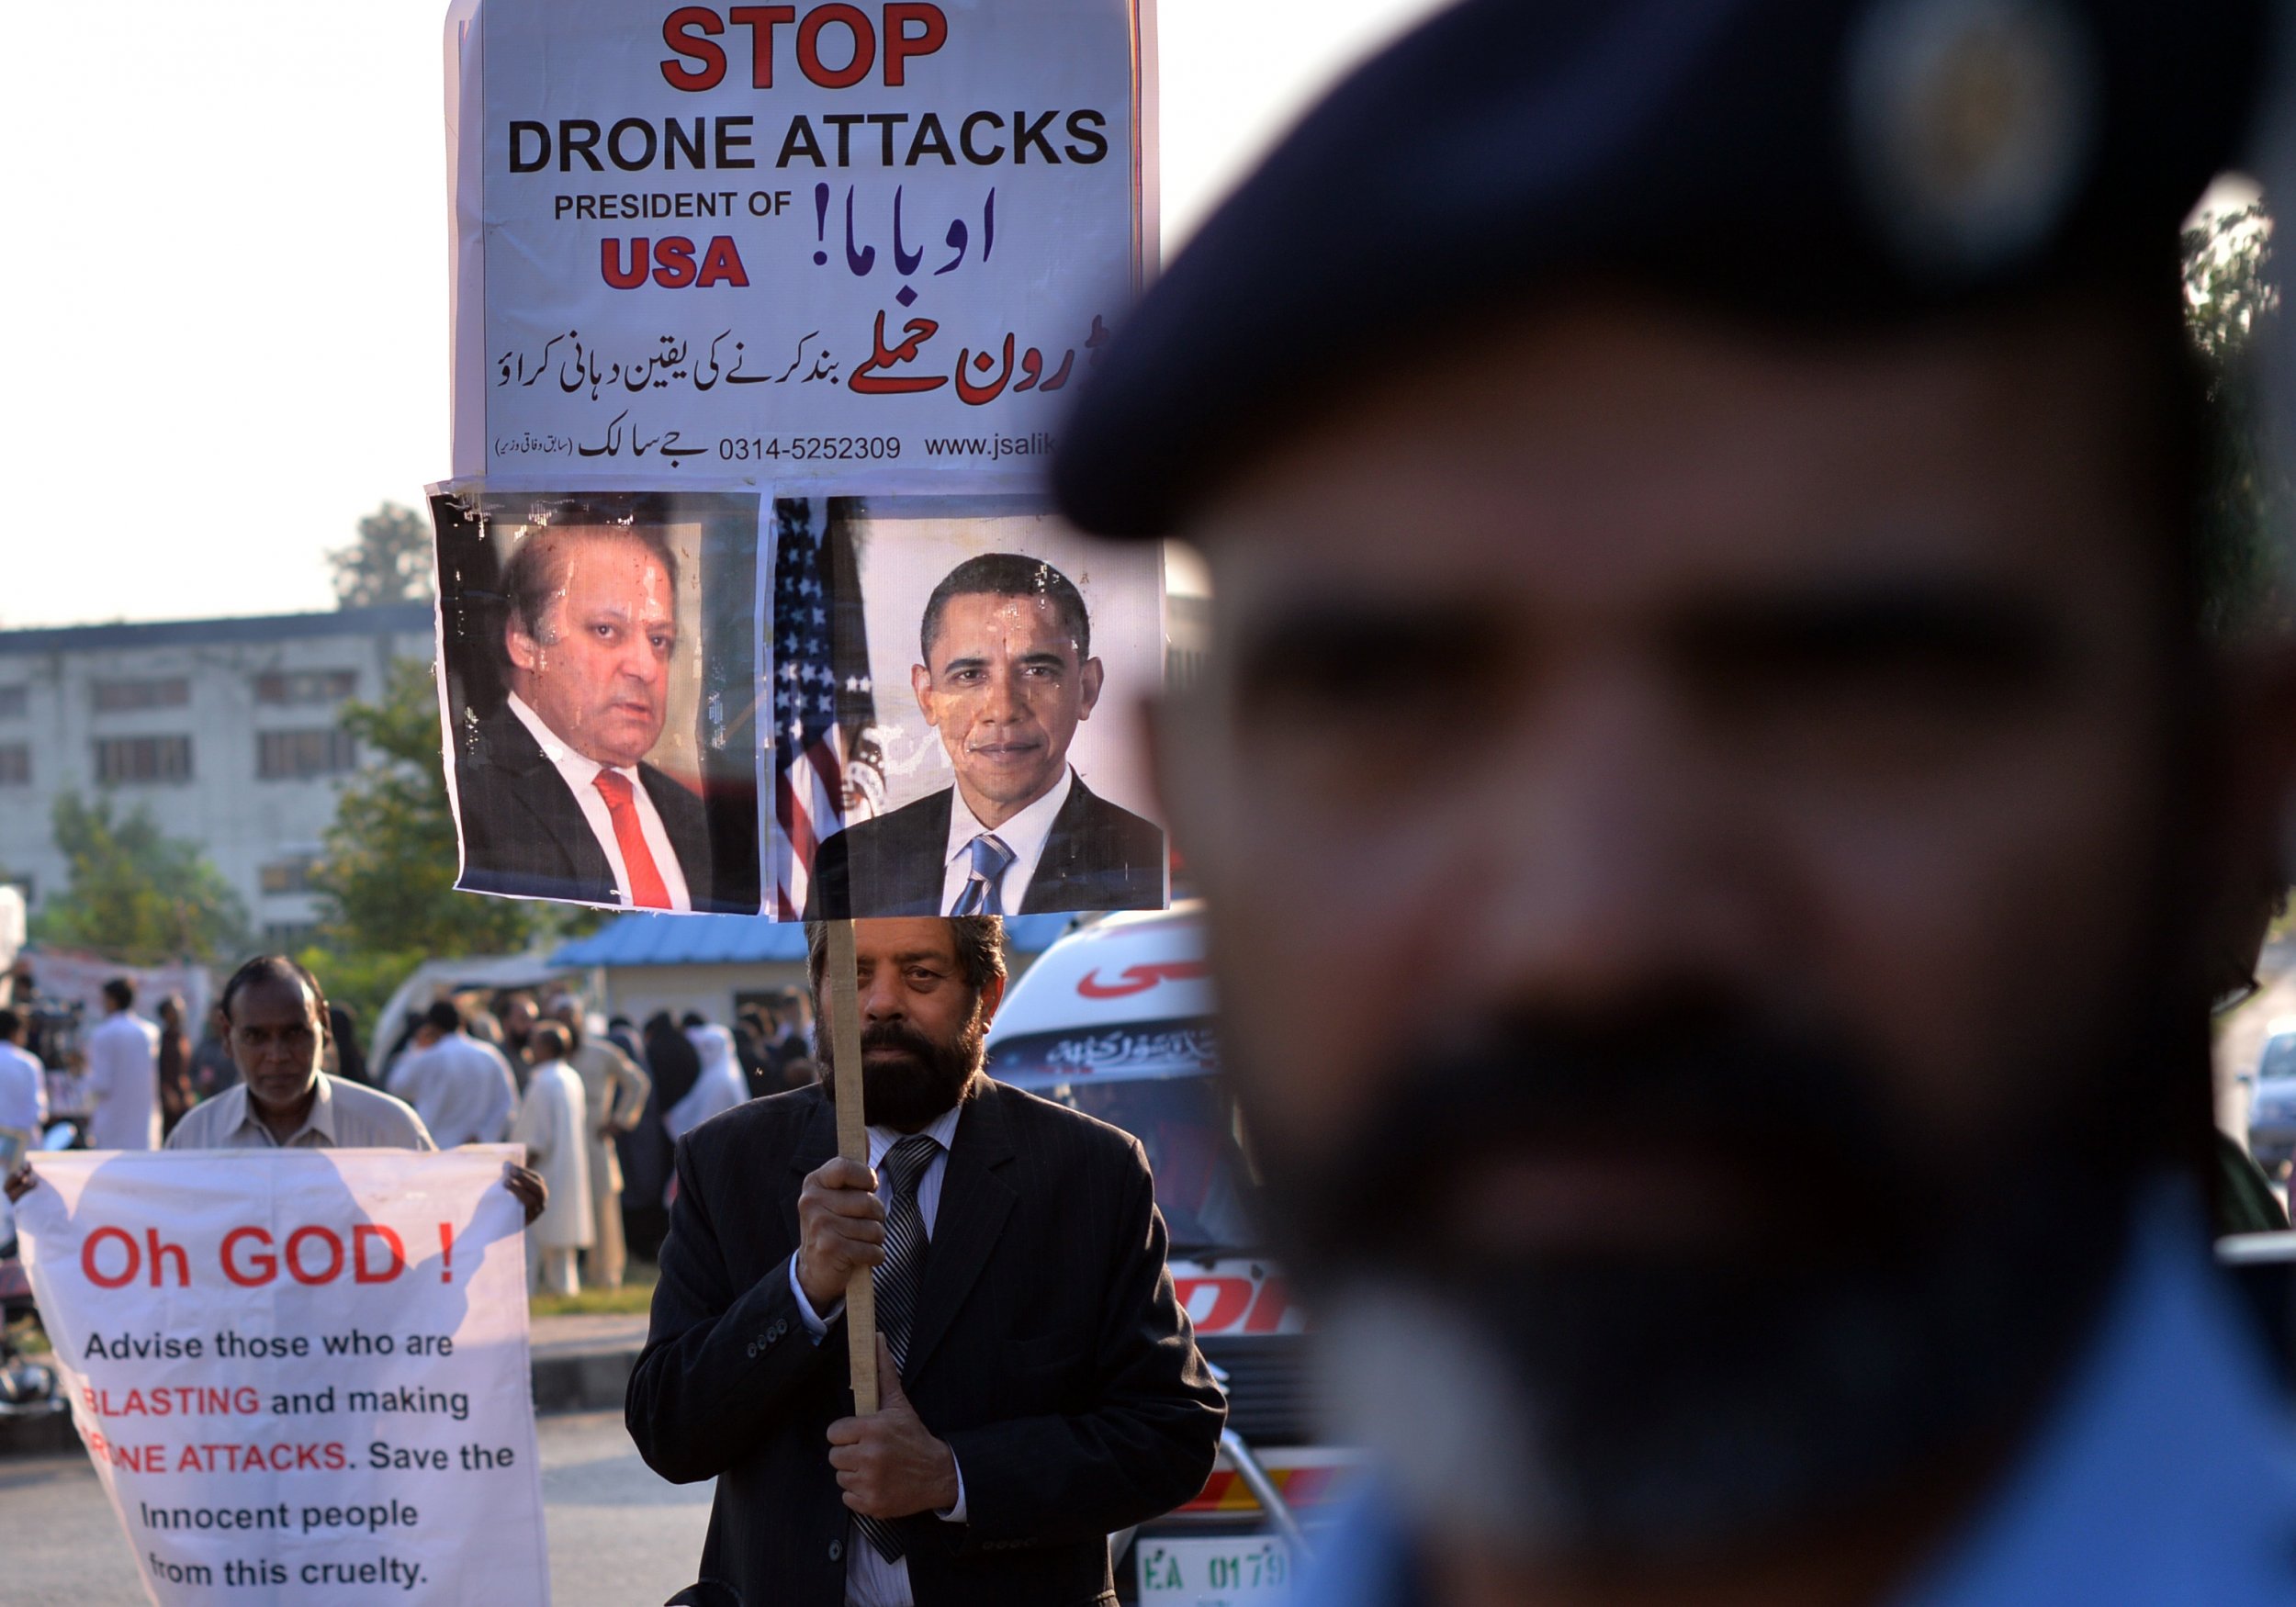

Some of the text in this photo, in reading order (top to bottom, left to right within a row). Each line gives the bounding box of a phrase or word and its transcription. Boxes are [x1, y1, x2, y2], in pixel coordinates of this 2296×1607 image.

[659, 3, 949, 93] STOP
[509, 108, 1109, 174] DRONE ATTACKS
[554, 190, 793, 220] PRESIDENT OF
[600, 236, 750, 290] USA
[559, 330, 621, 401] دہانی
[625, 334, 688, 393] یقین
[694, 329, 732, 391] کی
[725, 330, 820, 385] کرنے
[801, 349, 840, 385] بند
[848, 309, 949, 395] حملے
[659, 432, 709, 468] جے
[719, 436, 901, 461] 0314-5252309
[925, 433, 1054, 460] www.jsalik
[81, 1222, 454, 1288] Oh GOD !
[84, 1329, 454, 1360] Advise those who are
[83, 1386, 469, 1421] BLASTING and making
[178, 1442, 356, 1473] ATTACKS.
[368, 1441, 448, 1471] Save
[459, 1443, 514, 1471] the
[141, 1499, 419, 1534] Innocent people
[149, 1553, 428, 1591] from this cruelty.
